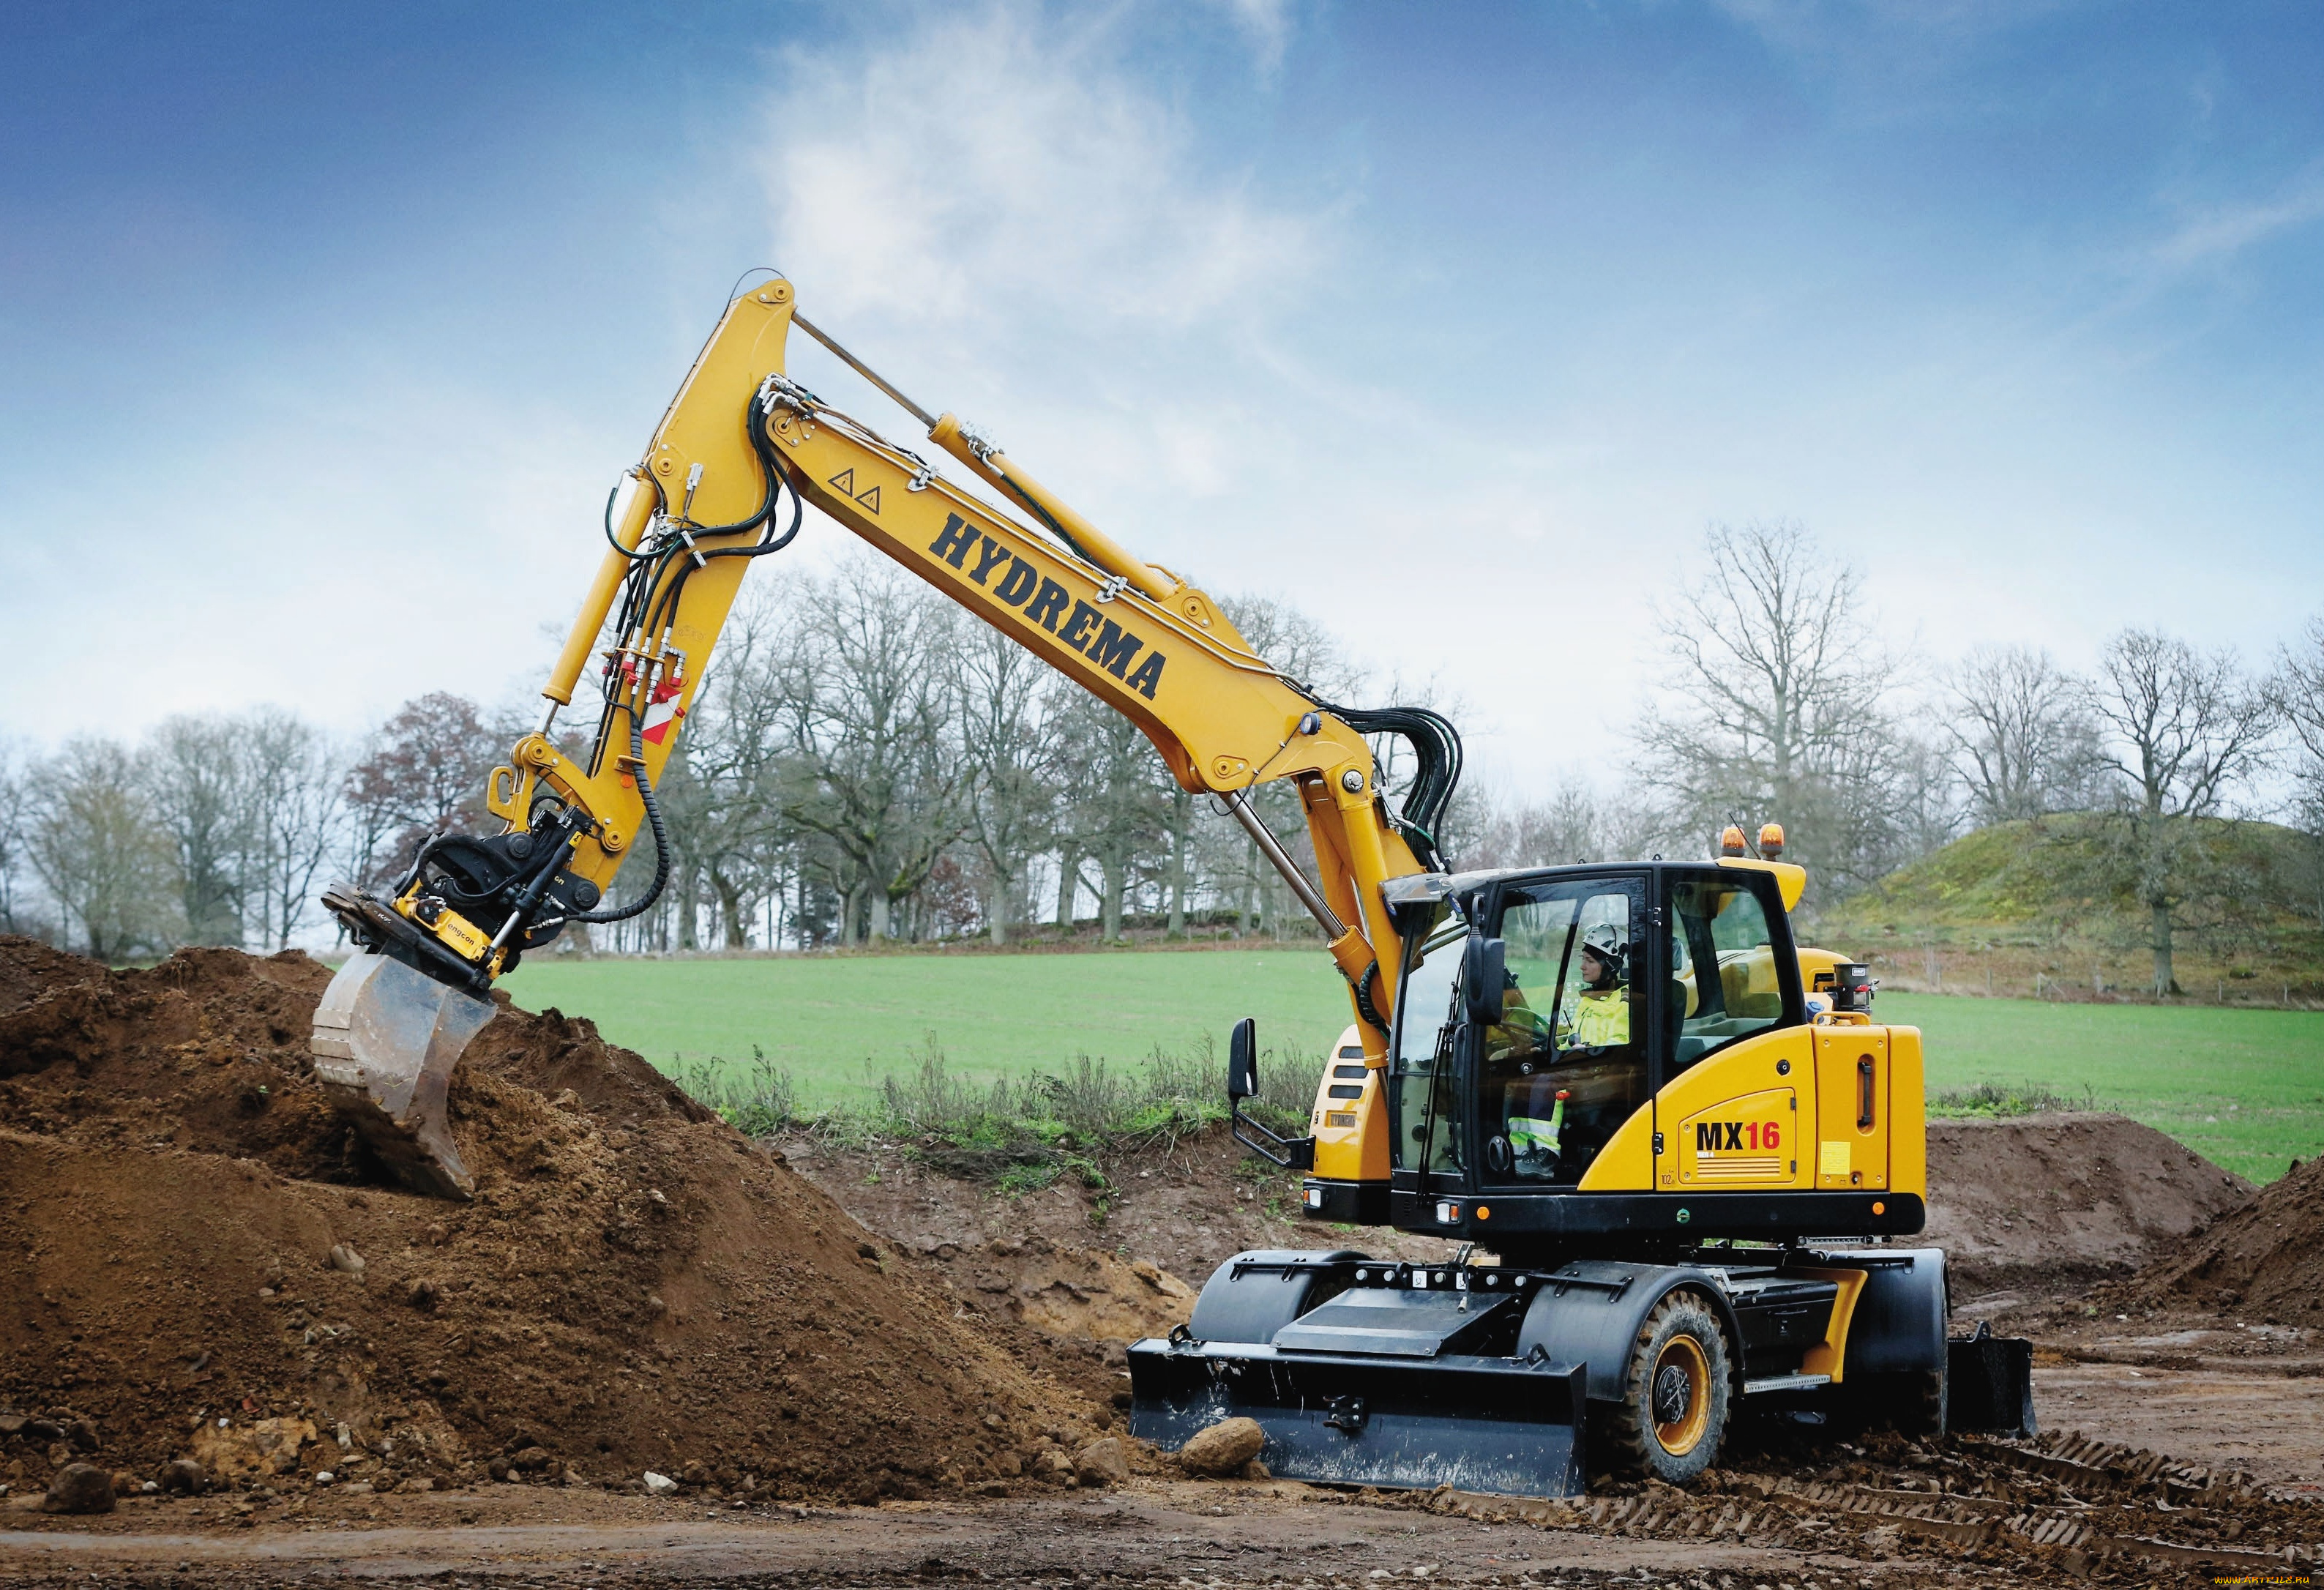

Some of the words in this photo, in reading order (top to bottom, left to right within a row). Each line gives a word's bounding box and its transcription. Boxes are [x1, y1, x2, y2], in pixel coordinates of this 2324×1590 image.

[928, 512, 1166, 701] HYDREMA
[447, 924, 474, 945] engcon
[1697, 1121, 1779, 1151] MX16
[1662, 1174, 1671, 1184] 102
